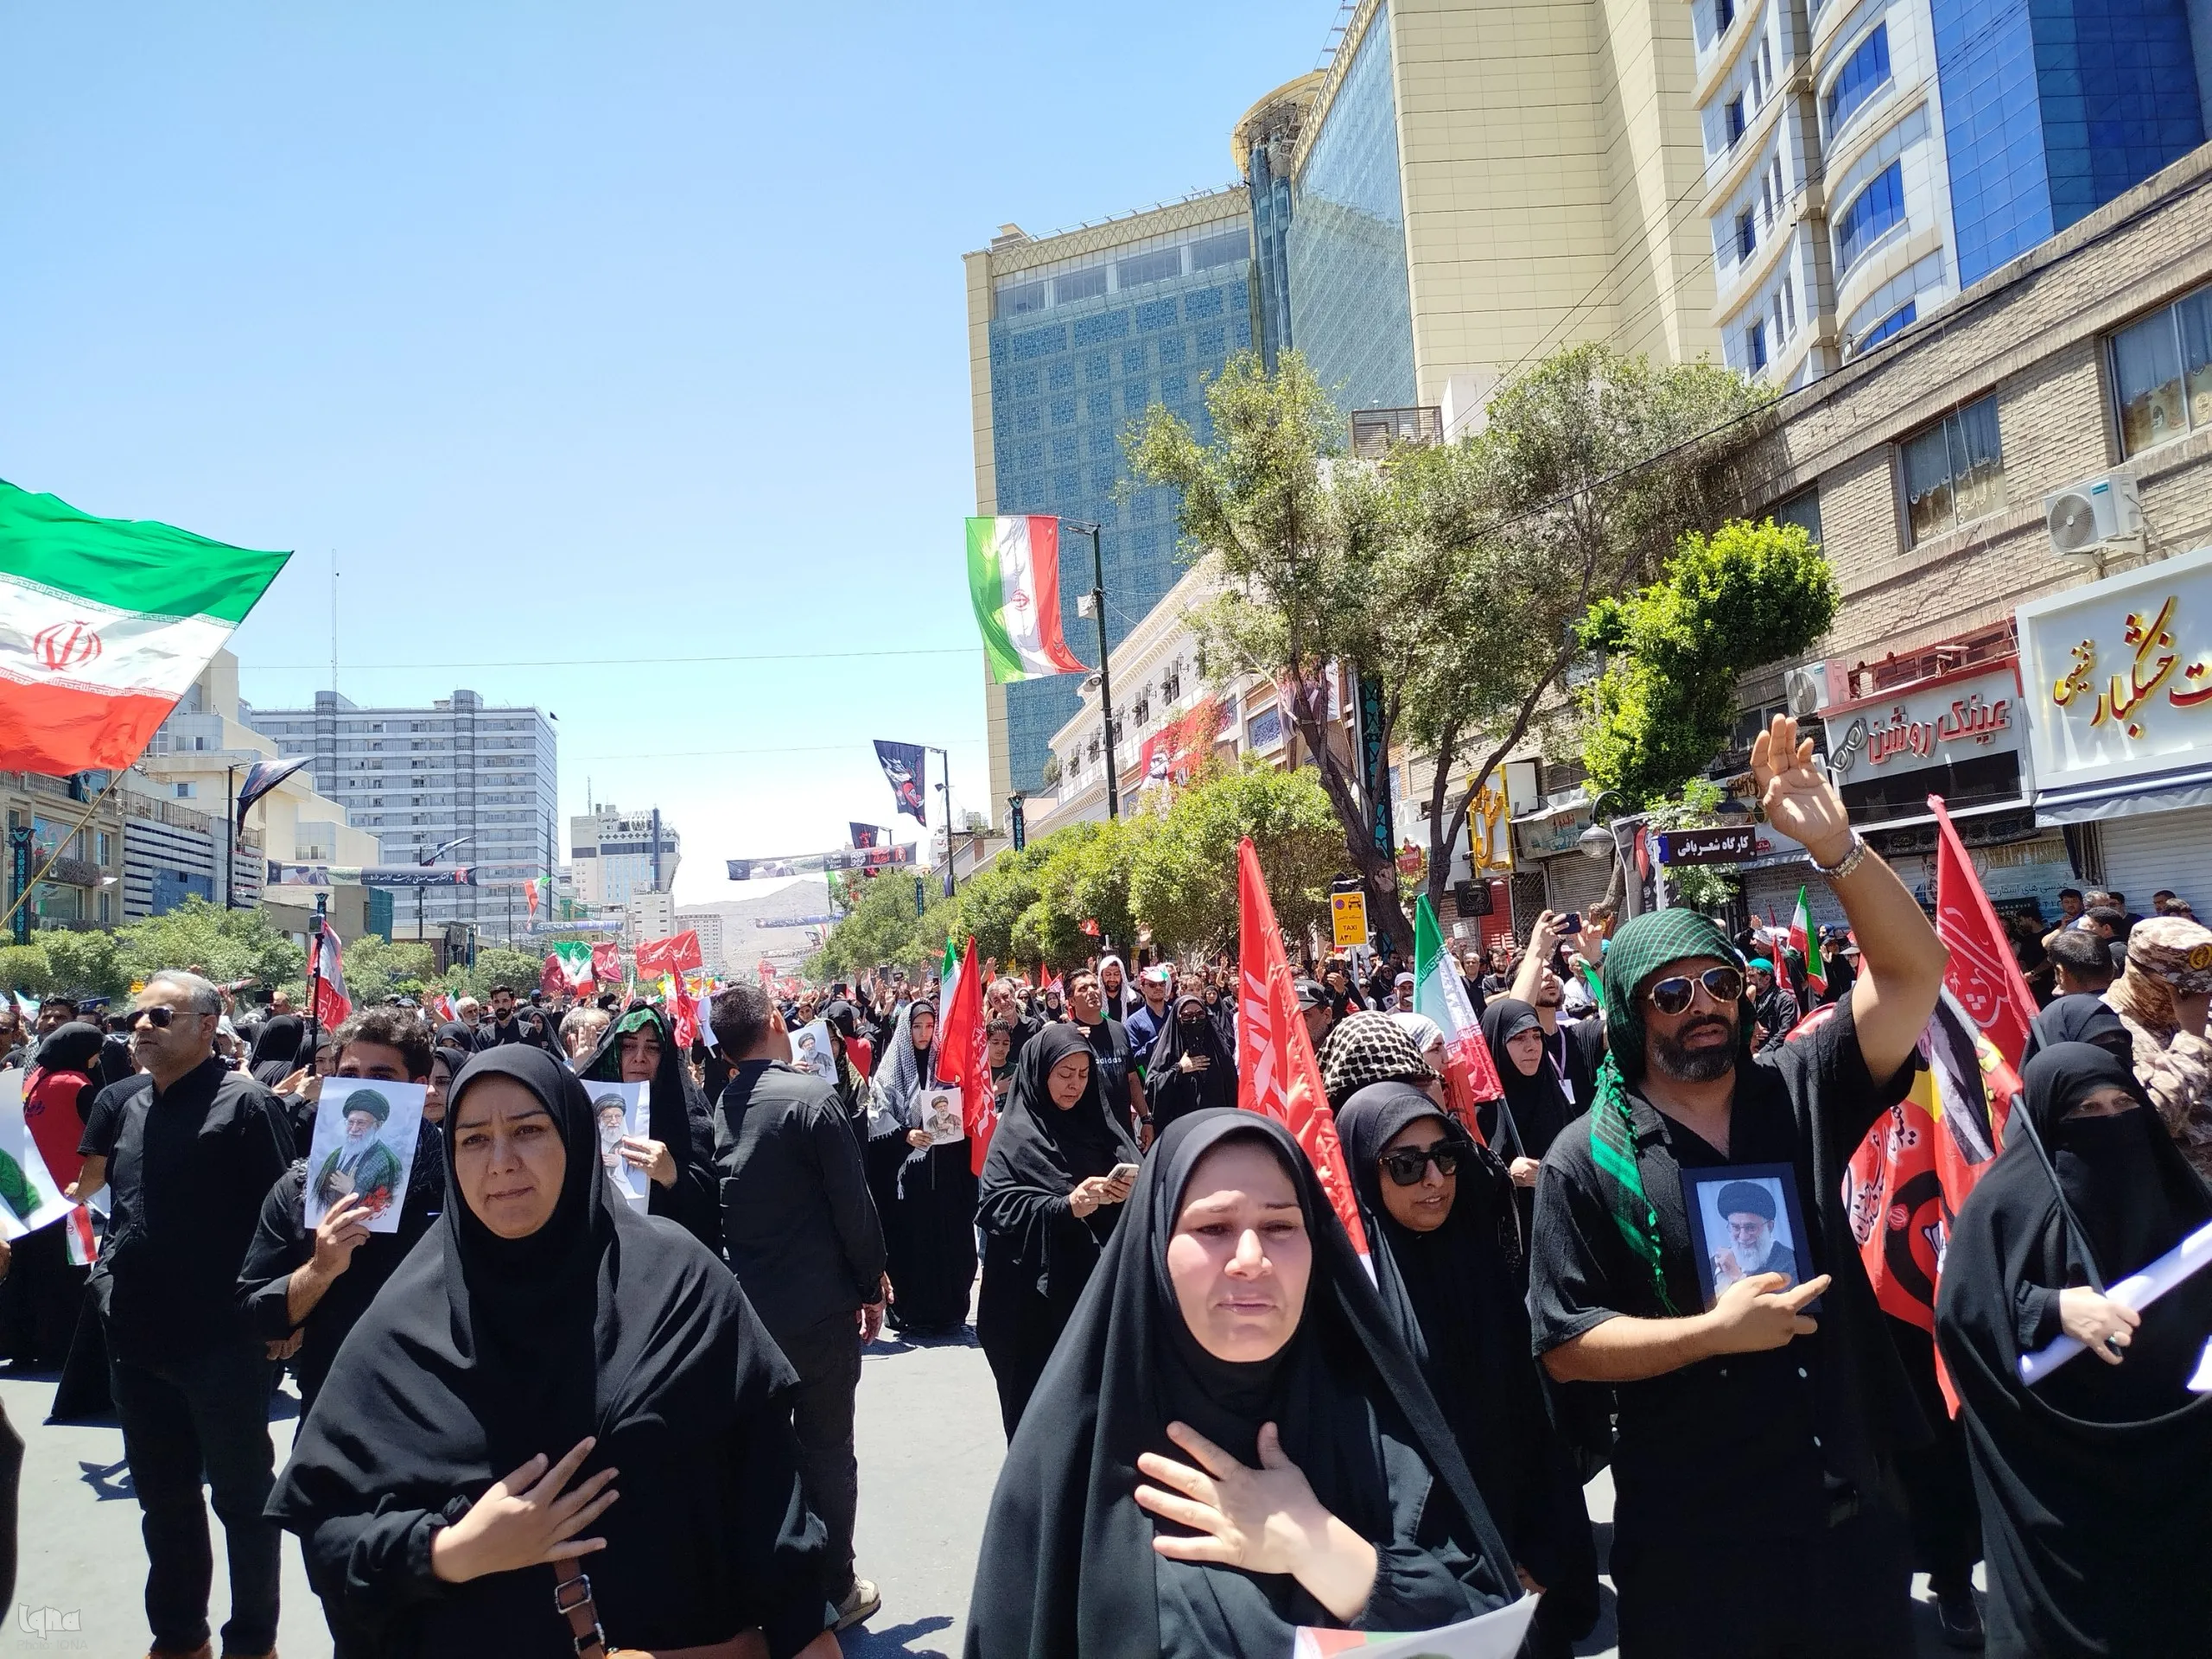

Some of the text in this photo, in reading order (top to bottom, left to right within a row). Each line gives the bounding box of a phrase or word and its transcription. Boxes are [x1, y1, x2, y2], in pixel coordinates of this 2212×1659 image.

[2089, 595, 2183, 741] خشکبار
[1867, 693, 2013, 766] عینک روشن
[1721, 835, 1749, 854] کارگاه
